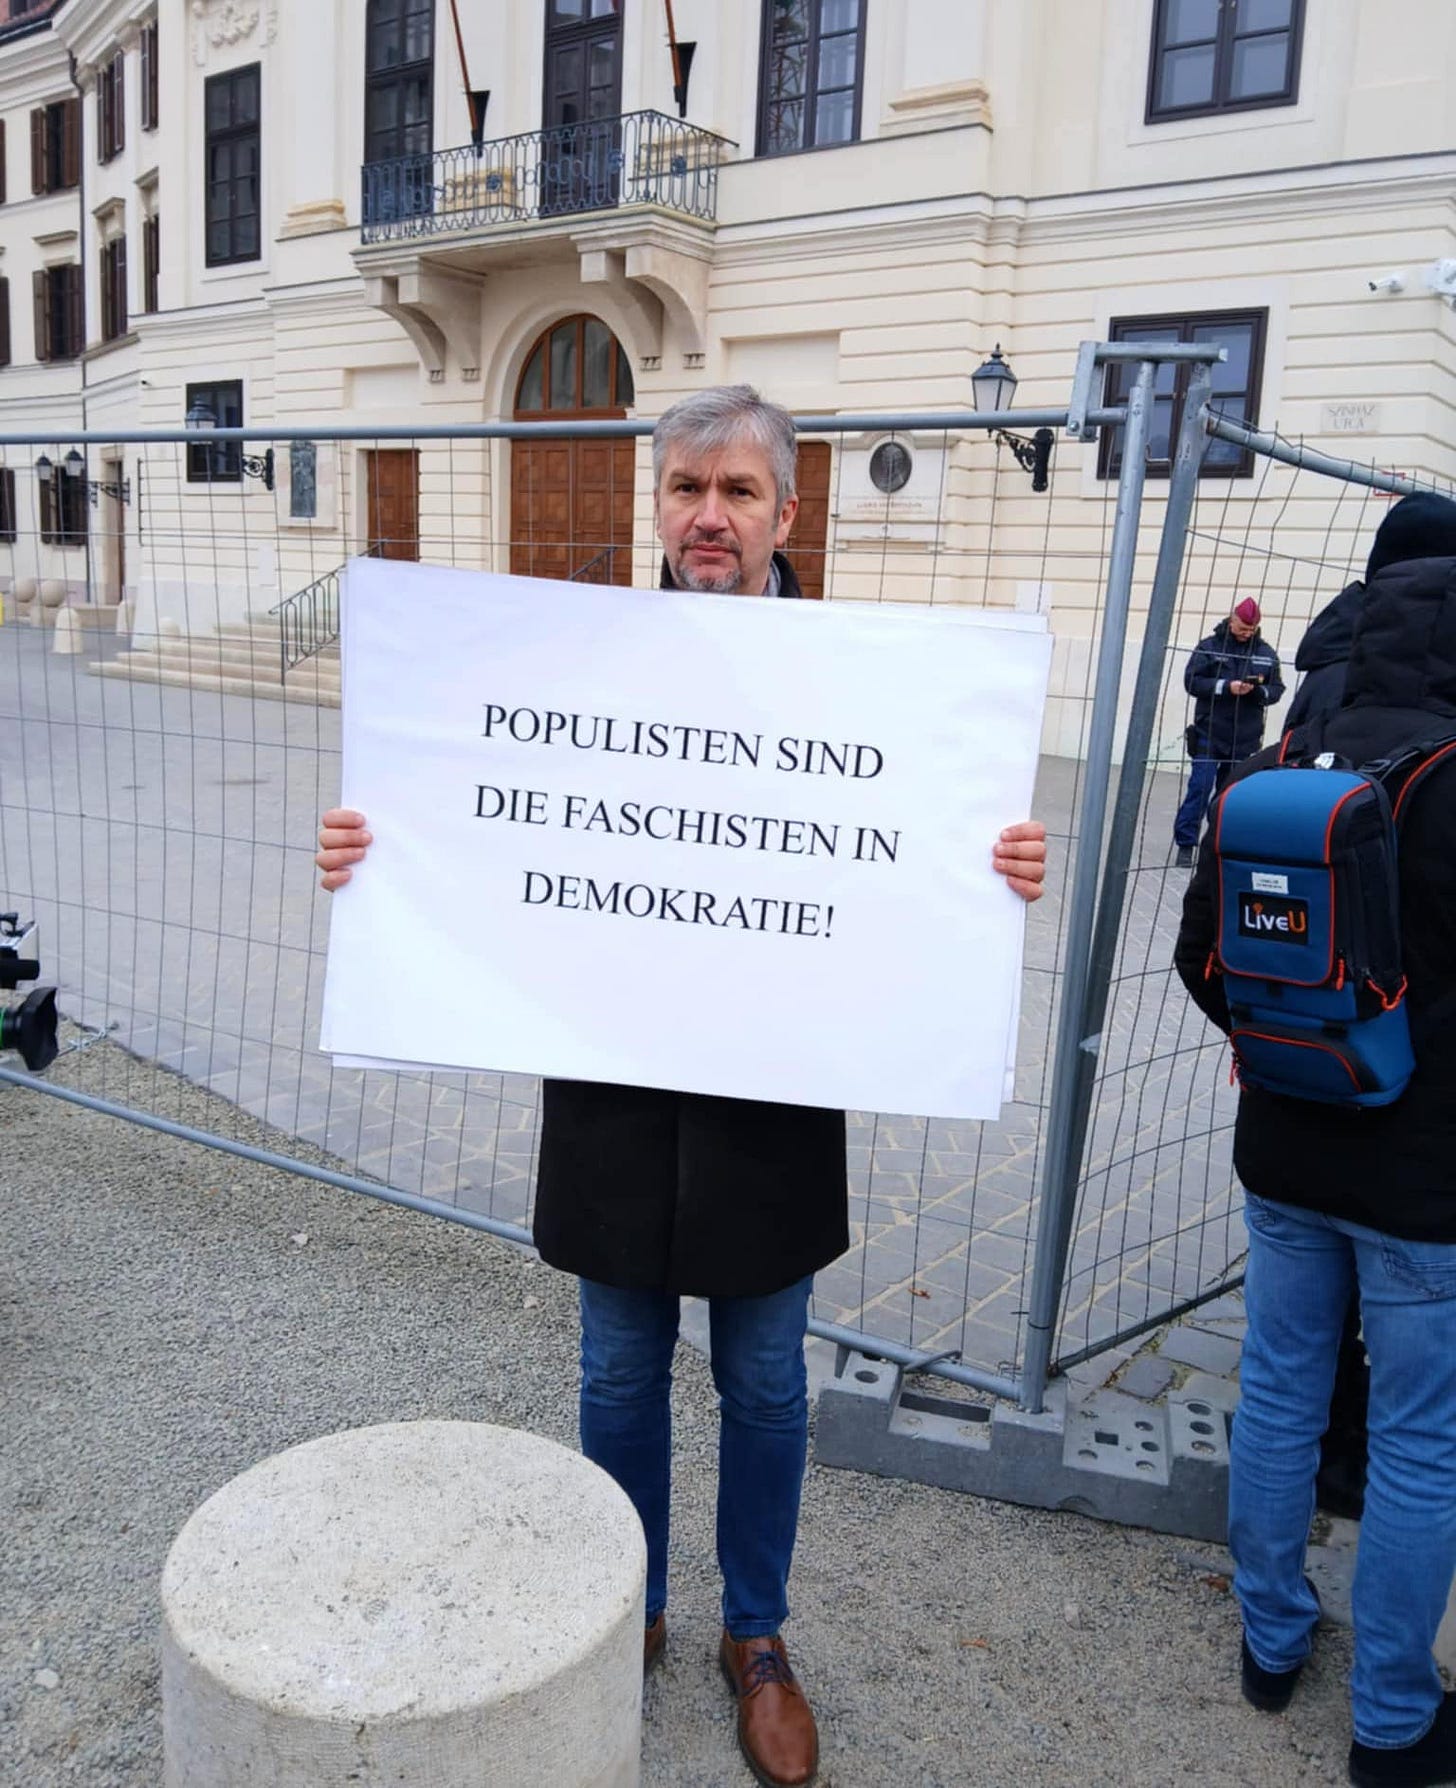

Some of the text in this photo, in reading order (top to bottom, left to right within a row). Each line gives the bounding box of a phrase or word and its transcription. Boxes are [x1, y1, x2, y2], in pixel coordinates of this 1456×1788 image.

[481, 704, 884, 779] POPULISTEN SIND
[474, 785, 901, 863] DIE FASCHISTEN IN
[521, 871, 835, 938] DEMOKRATIE!
[1244, 902, 1306, 933] LiveU
